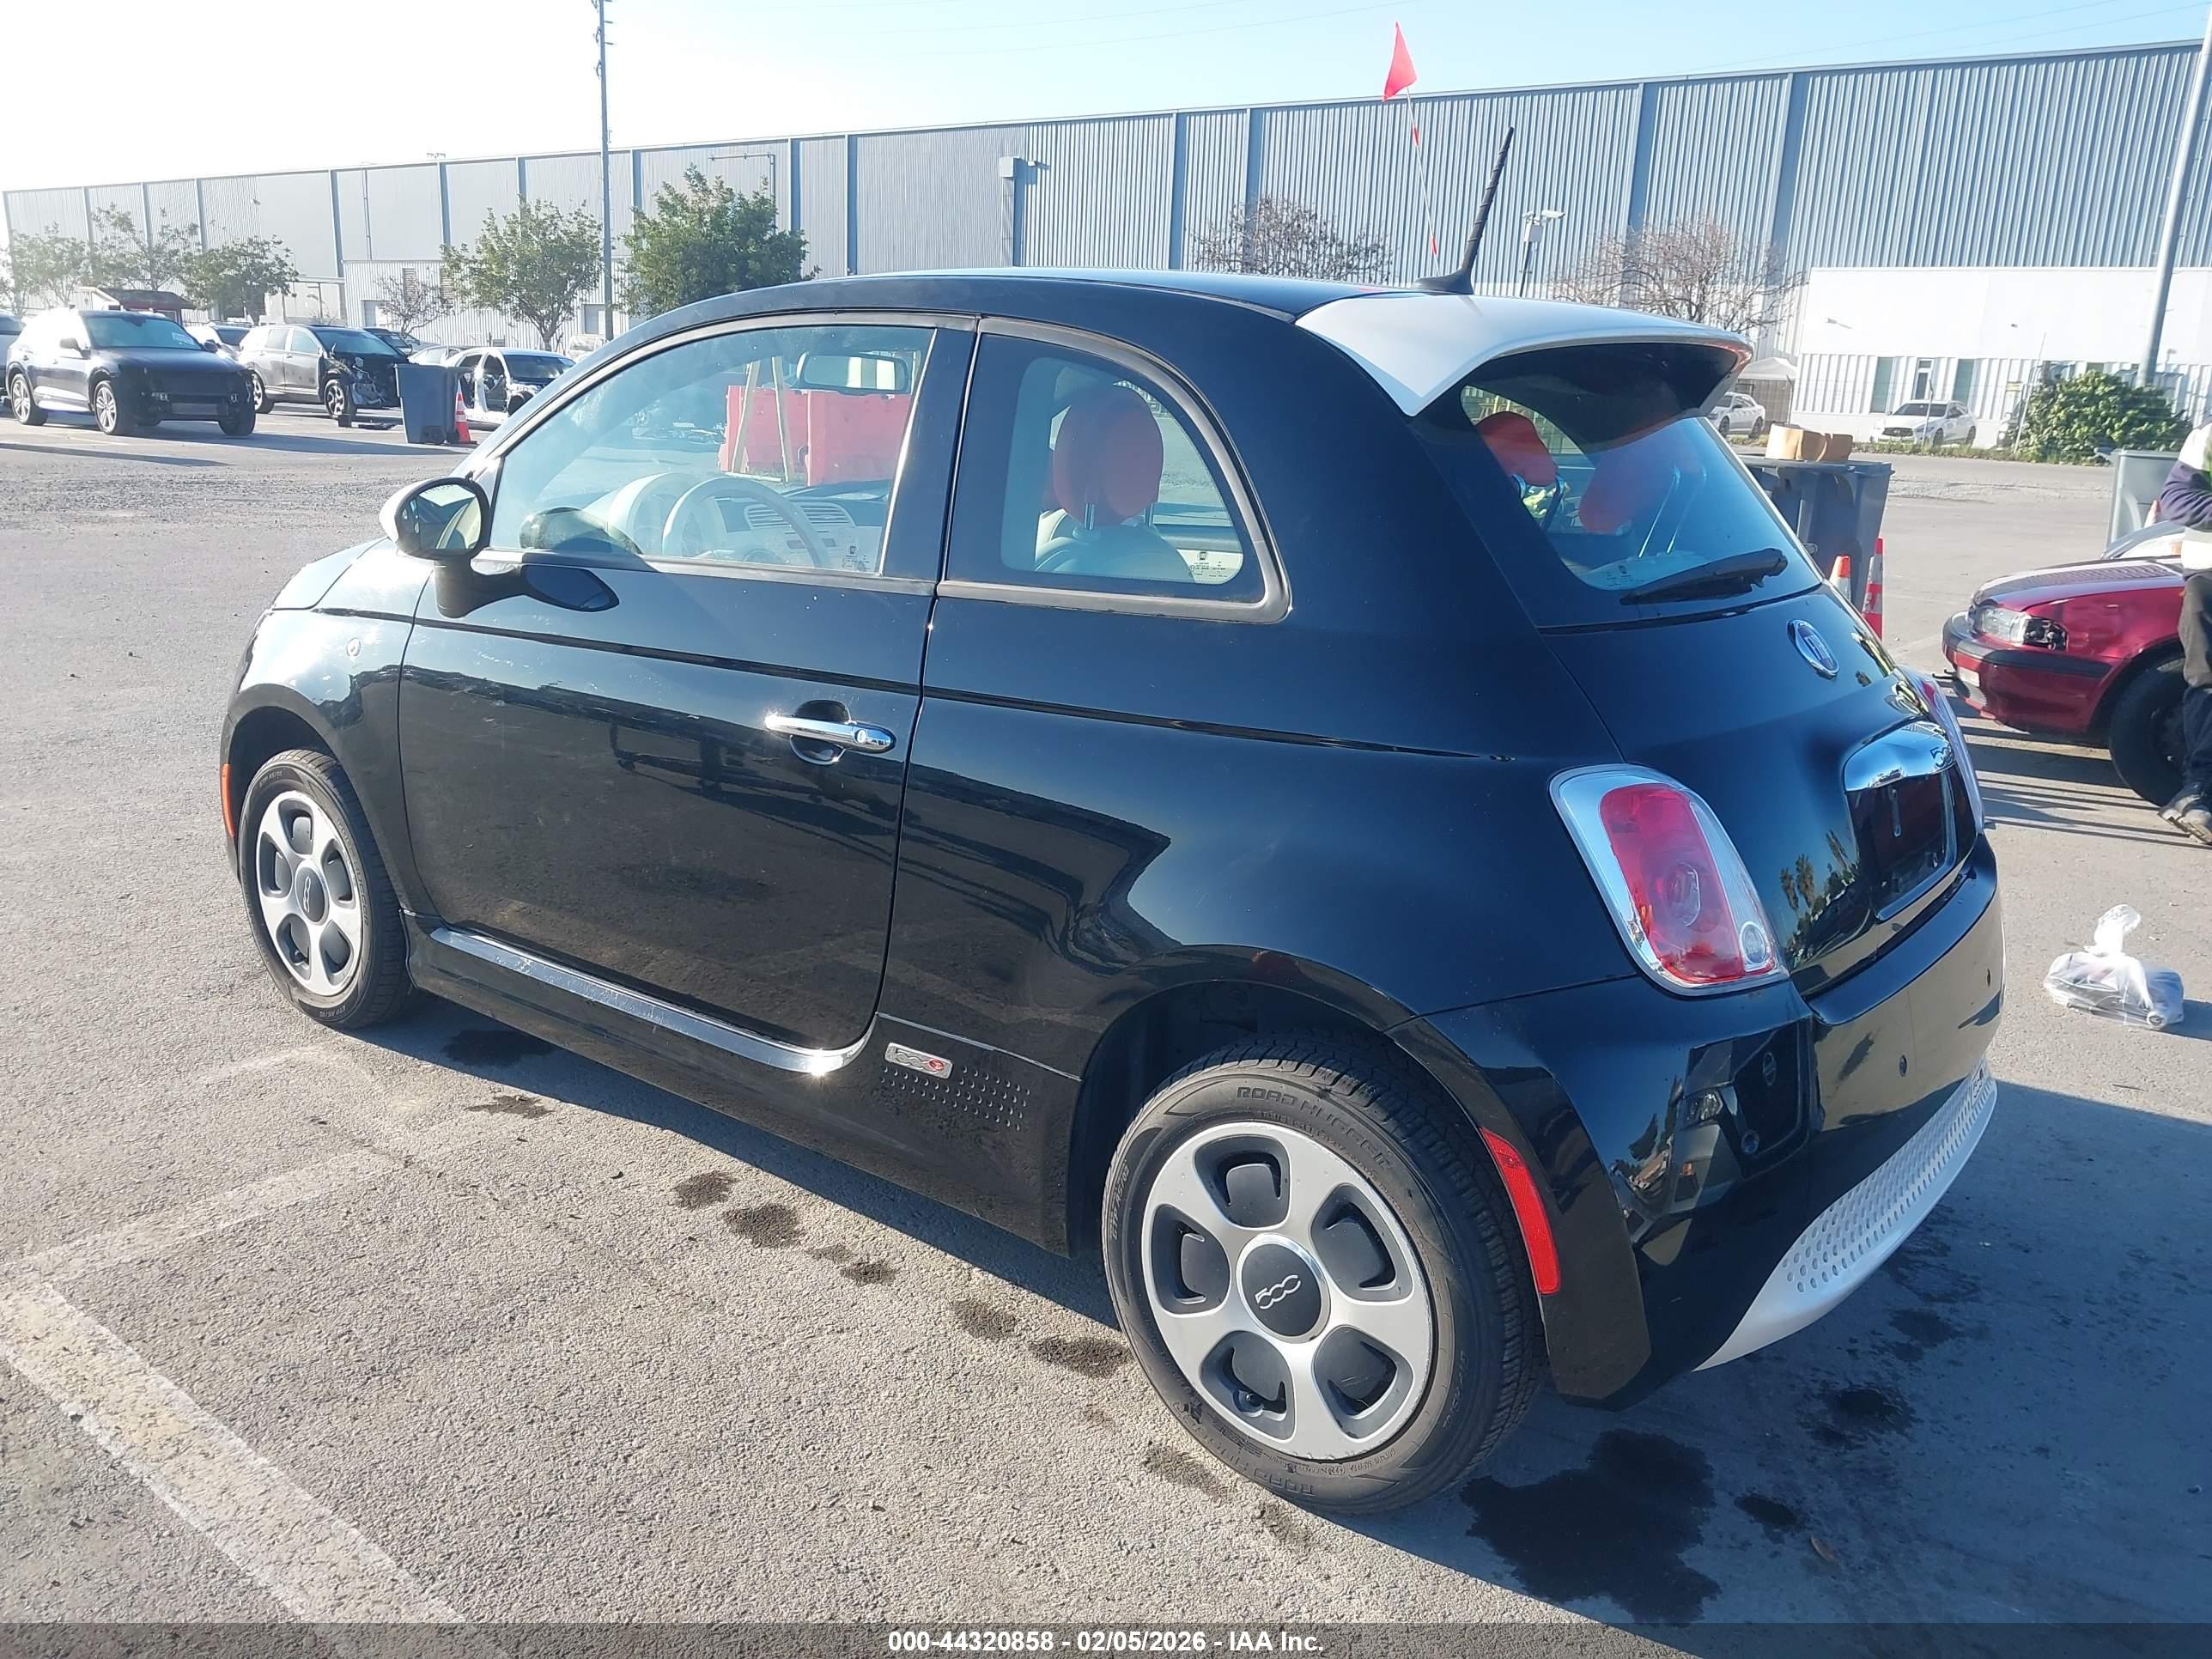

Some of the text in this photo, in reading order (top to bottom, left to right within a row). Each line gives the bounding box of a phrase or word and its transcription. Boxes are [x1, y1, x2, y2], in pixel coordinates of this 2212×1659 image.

[1237, 1085, 1298, 1107] ROAD
[1299, 1099, 1395, 1170] HUGGER
[1255, 1274, 1302, 1310] 500
